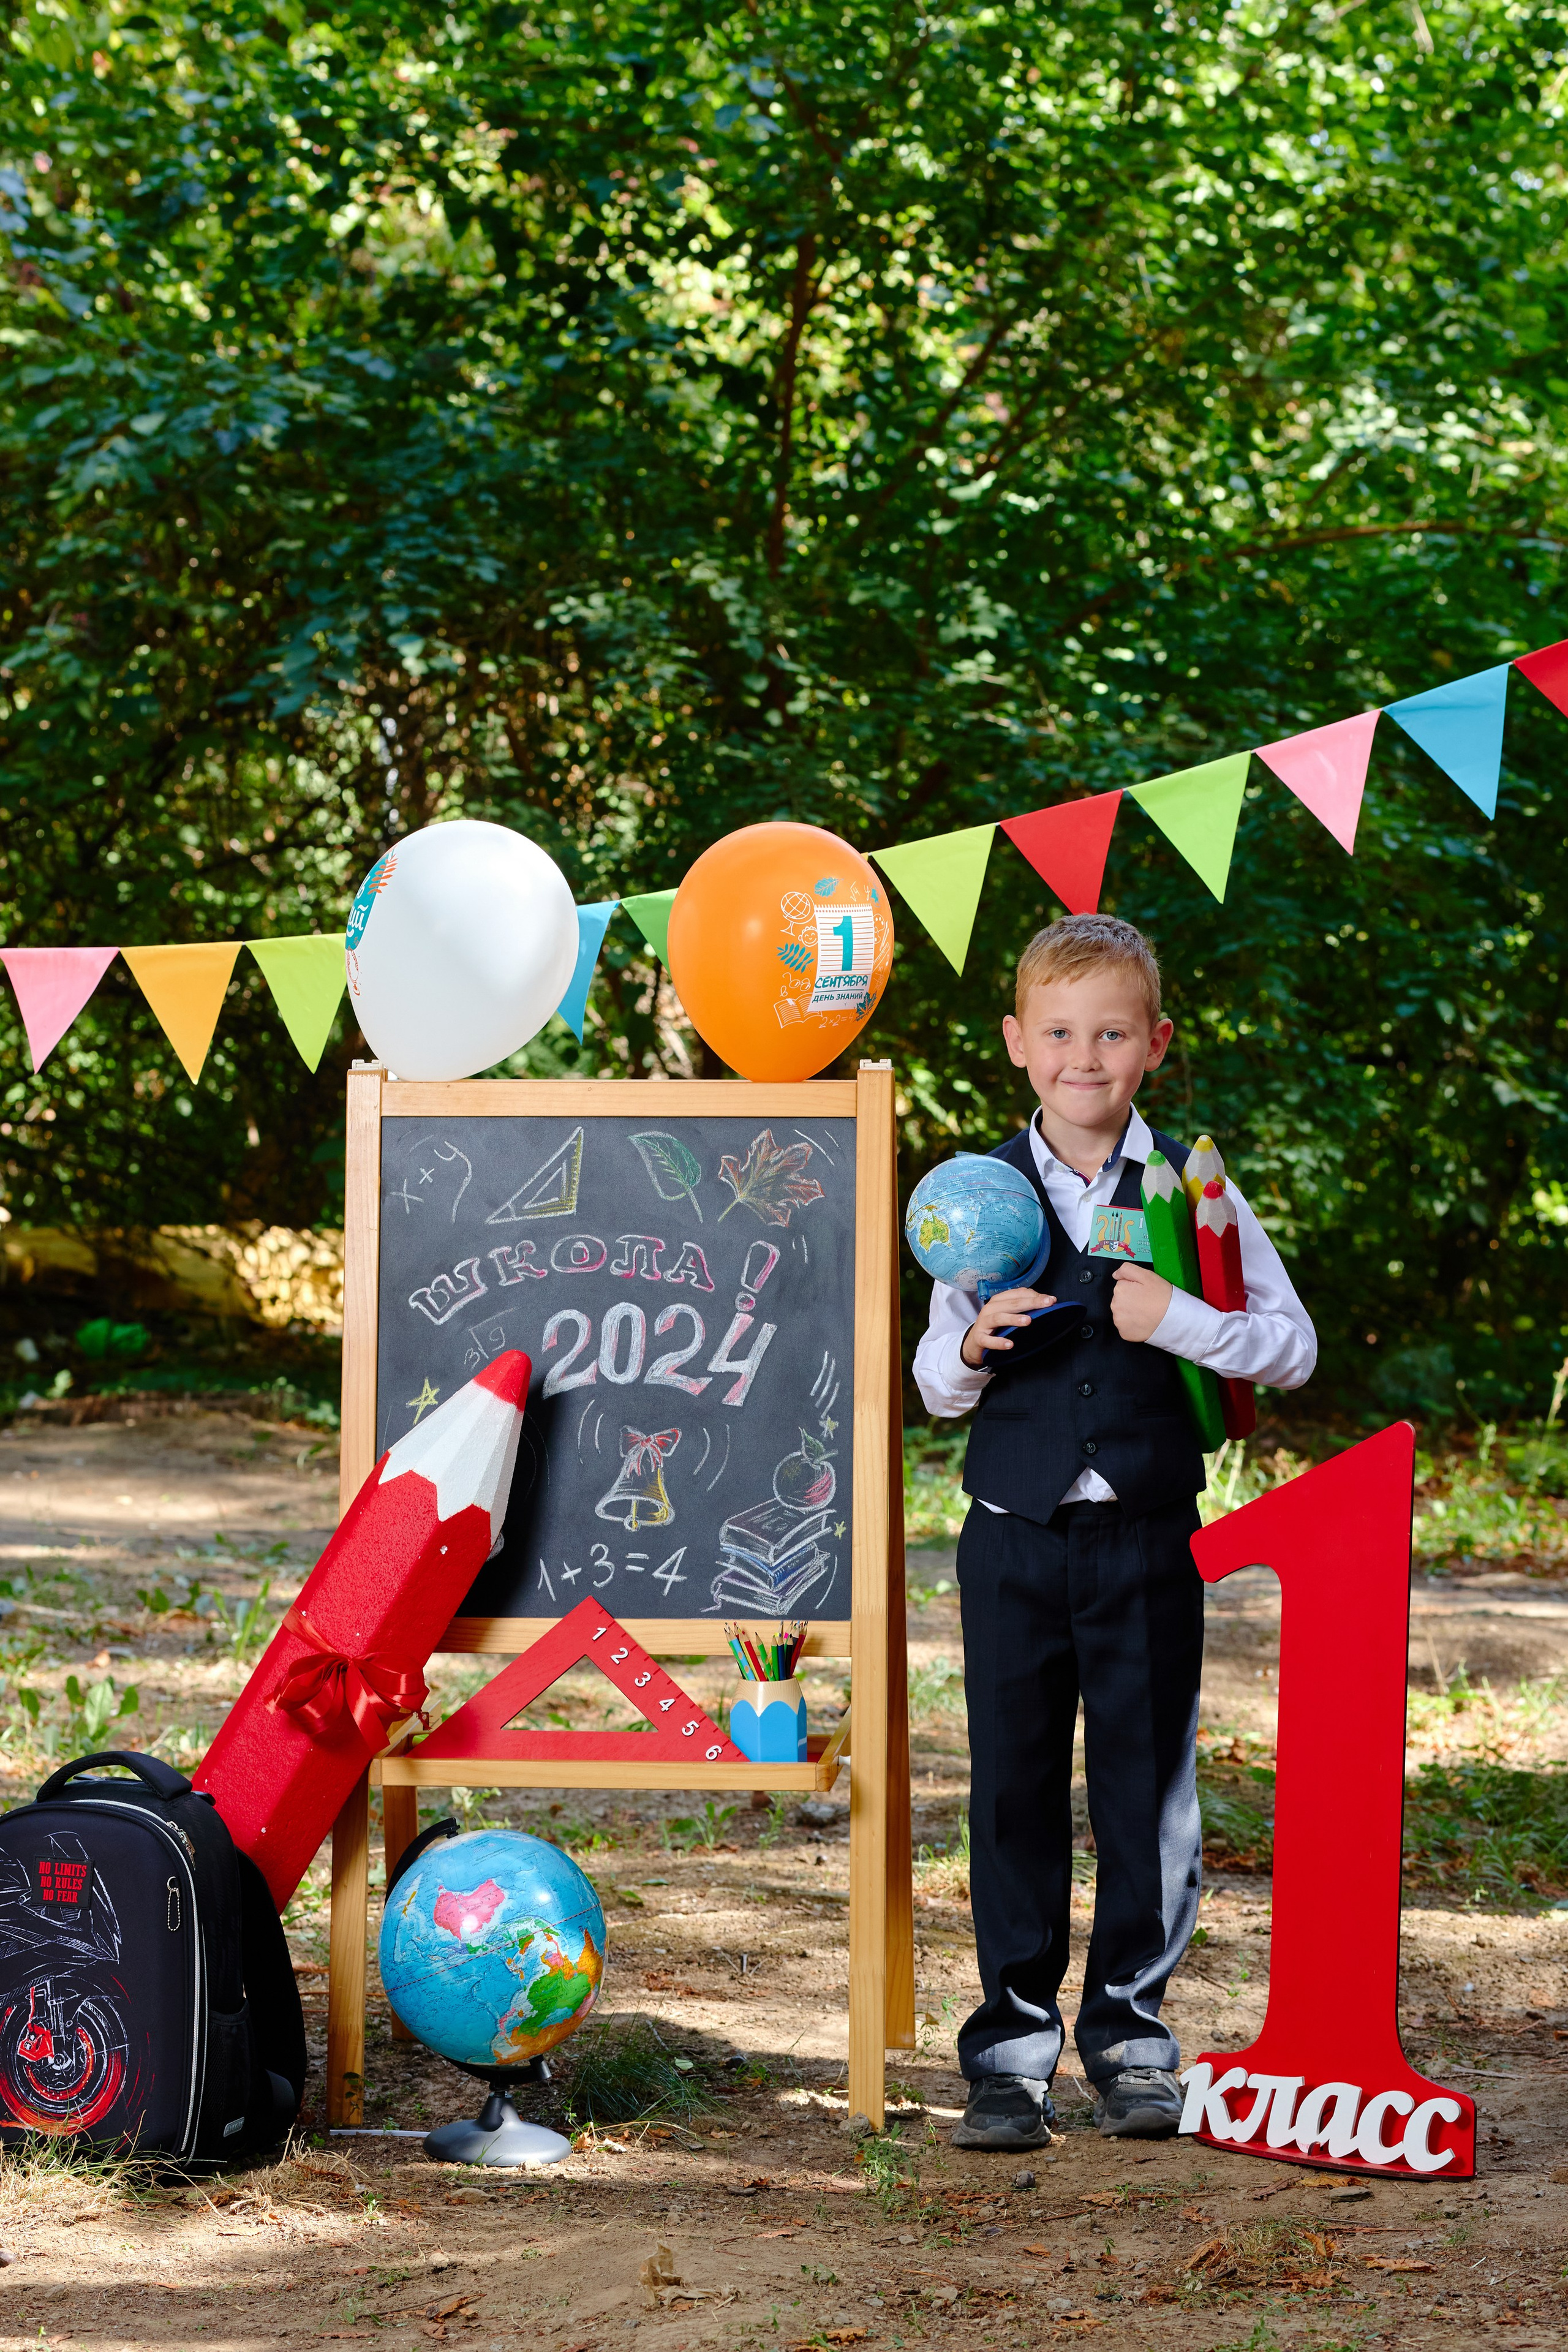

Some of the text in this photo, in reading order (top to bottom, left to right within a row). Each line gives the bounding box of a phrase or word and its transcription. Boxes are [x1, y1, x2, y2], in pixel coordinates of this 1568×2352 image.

[832, 915, 853, 971] 1
[814, 974, 869, 989] СЕНТЯБРЯ
[812, 992, 863, 1003] ДЕНЬ ЗНАНИЙ
[541, 1302, 778, 1407] 2024
[592, 1627, 723, 1761] 1 2 3 4 5 6
[38, 1861, 87, 1877] NO LIMITS
[40, 1875, 83, 1890] NO RULES
[42, 1889, 78, 1903] NO FEAR
